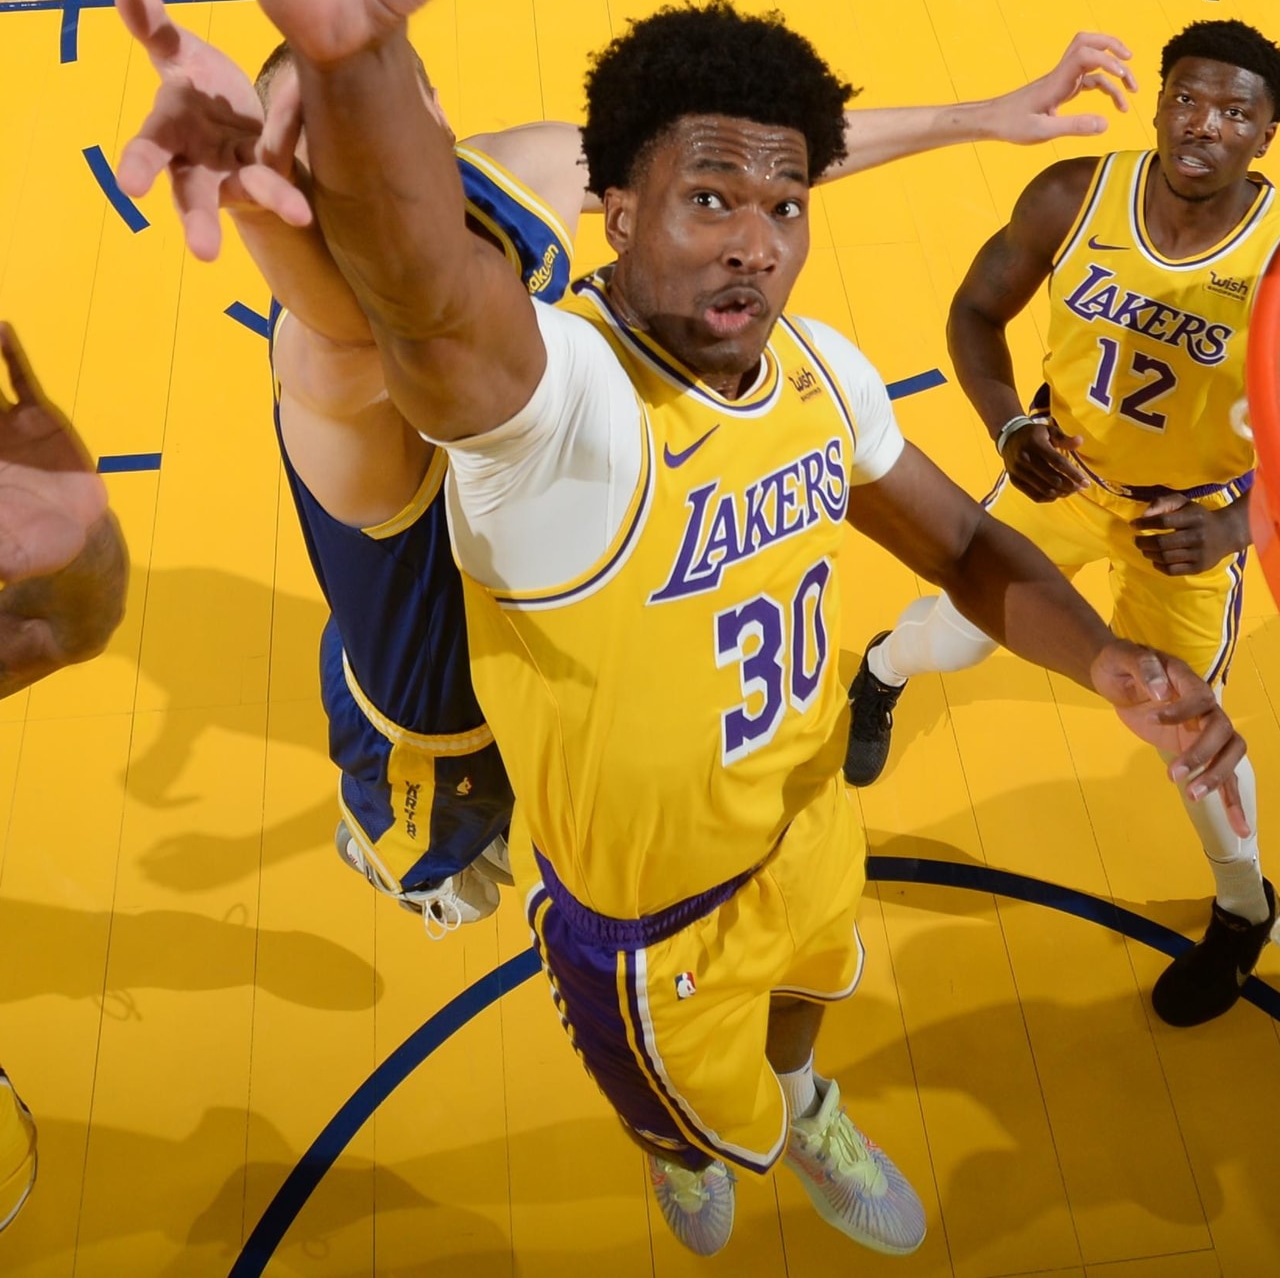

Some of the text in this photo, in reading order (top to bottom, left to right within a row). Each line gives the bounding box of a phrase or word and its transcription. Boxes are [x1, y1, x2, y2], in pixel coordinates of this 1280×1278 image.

[529, 244, 559, 293] akuten
[1064, 262, 1236, 366] LAKERS
[1210, 271, 1248, 295] wish
[788, 367, 817, 392] wish
[1086, 335, 1178, 434] 12
[645, 438, 851, 606] LAKERS
[714, 555, 832, 767] 30
